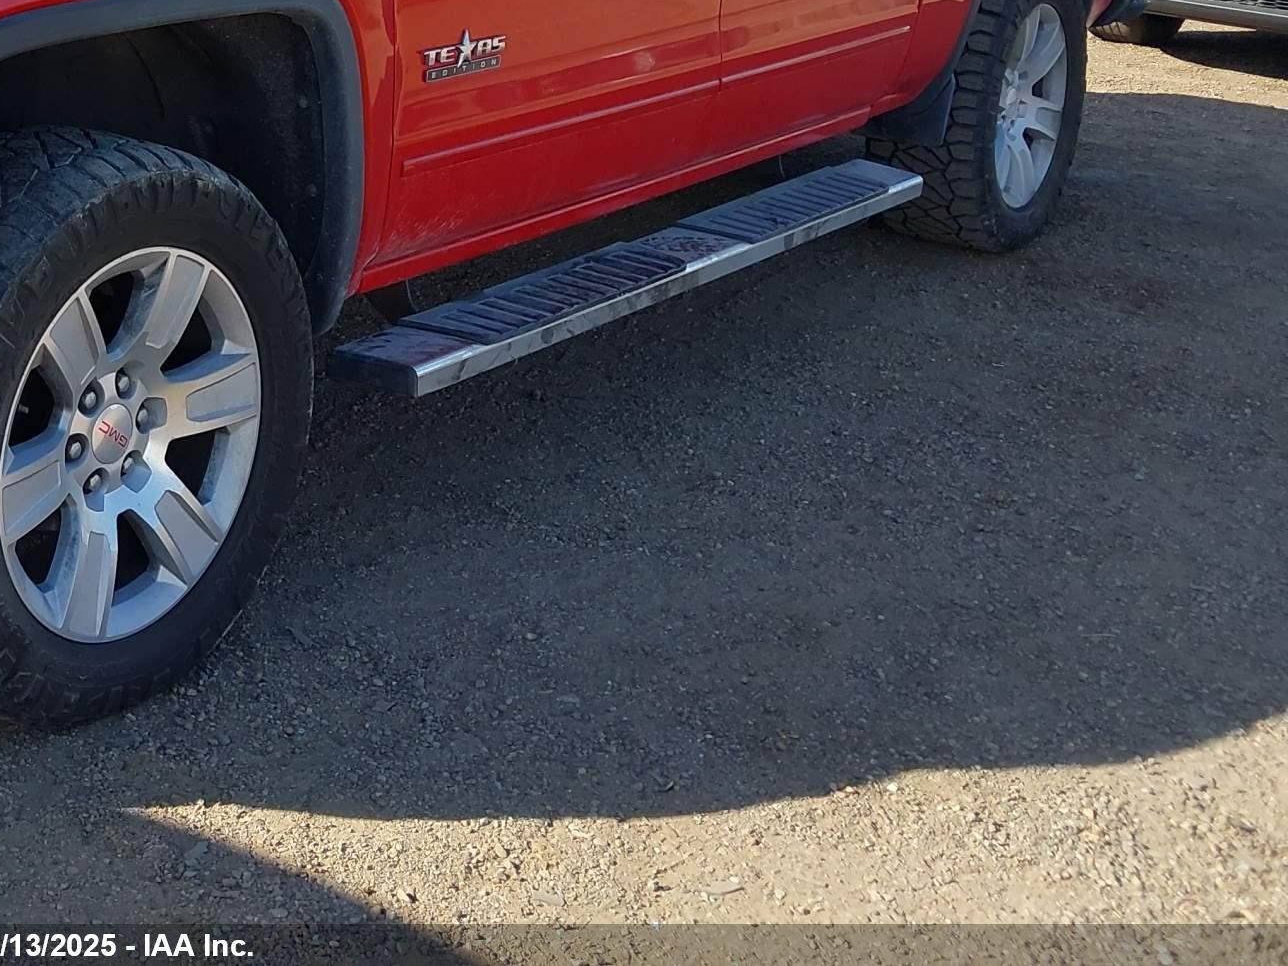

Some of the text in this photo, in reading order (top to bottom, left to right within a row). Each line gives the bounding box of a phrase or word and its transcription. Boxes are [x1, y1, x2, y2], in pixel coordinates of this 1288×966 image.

[423, 30, 507, 67] TEXAS
[431, 58, 497, 79] EDITION
[98, 420, 128, 448] GMC
